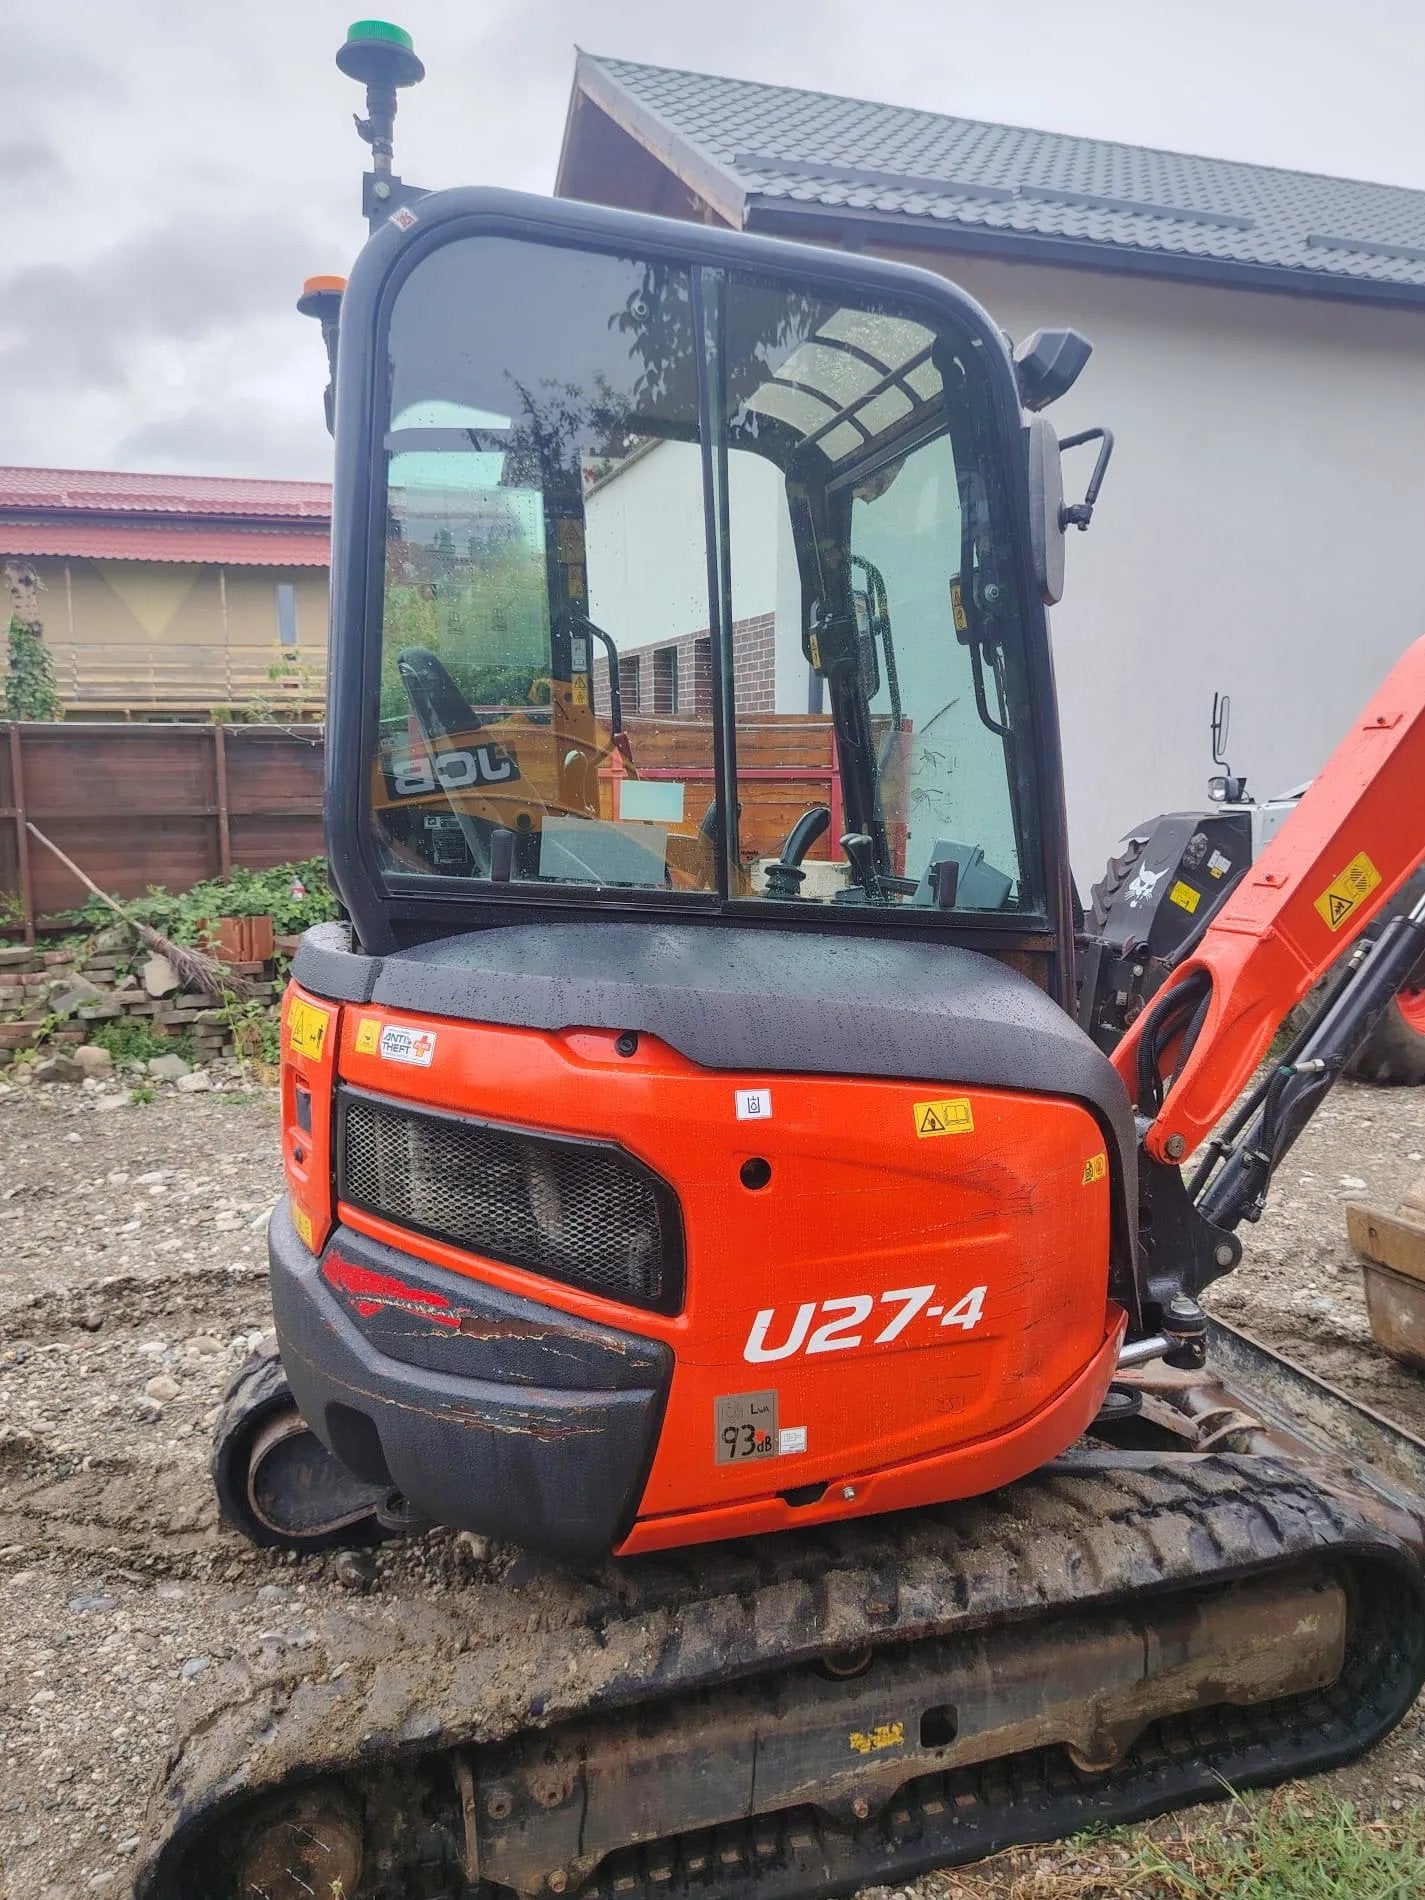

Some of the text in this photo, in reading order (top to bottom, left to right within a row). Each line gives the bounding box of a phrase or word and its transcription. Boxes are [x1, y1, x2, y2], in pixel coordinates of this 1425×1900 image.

[382, 1041, 412, 1055] THEFT
[743, 1285, 988, 1363] U27-4
[723, 1424, 772, 1458] 93 dB
